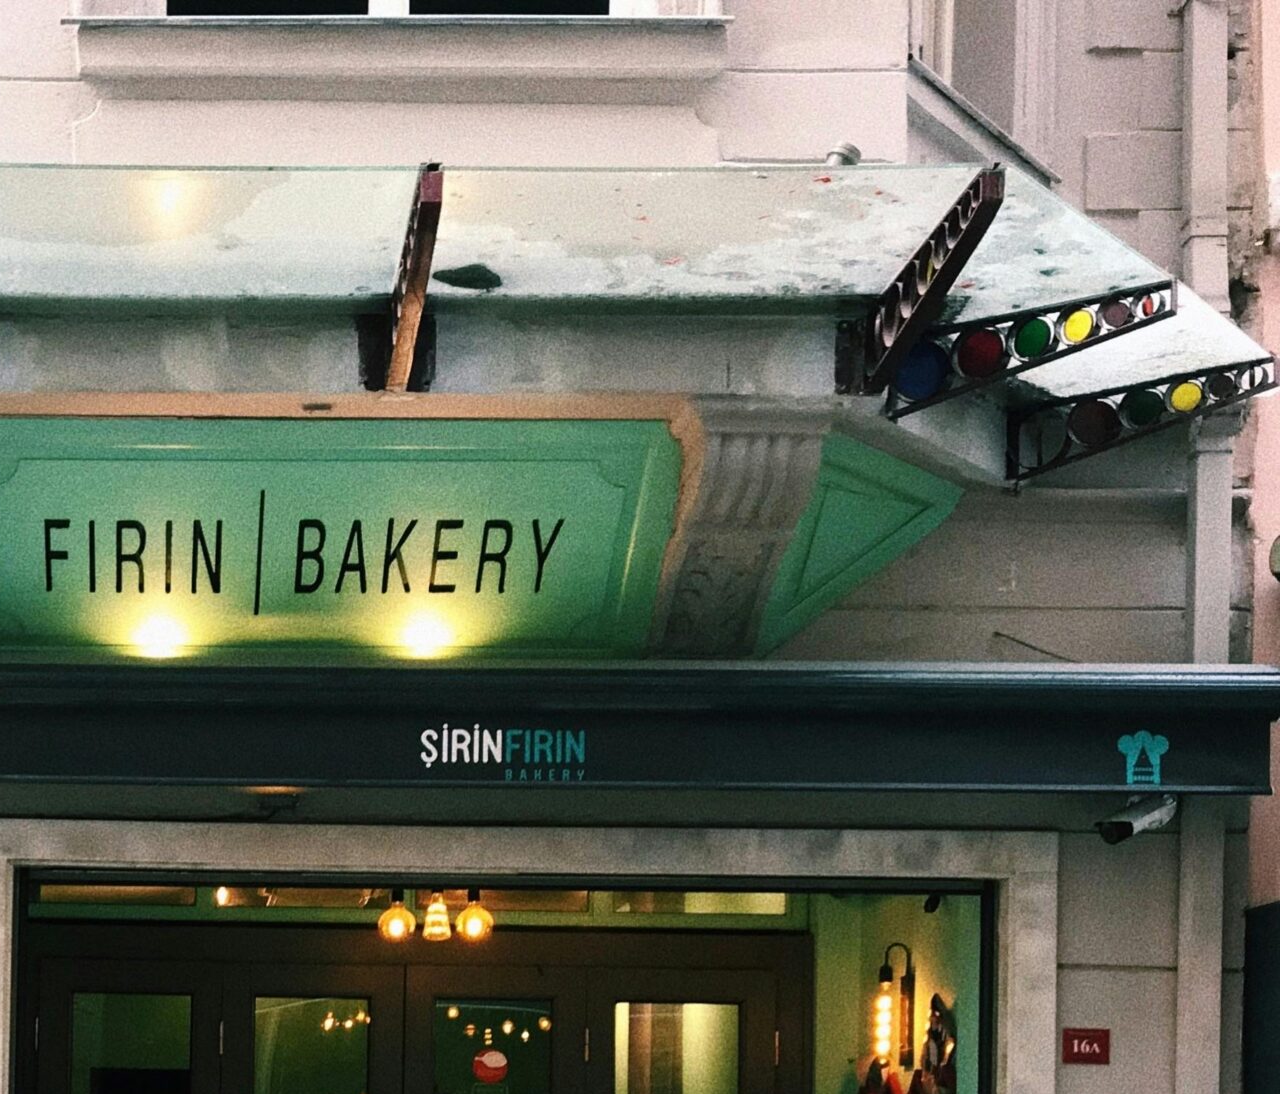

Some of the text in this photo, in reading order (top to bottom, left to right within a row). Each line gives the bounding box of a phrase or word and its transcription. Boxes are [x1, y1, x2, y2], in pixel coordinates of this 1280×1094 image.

[44, 518, 565, 594] FIRIN BAKERY
[505, 769, 585, 782] BAKERY
[1072, 1039, 1101, 1054] 16A
